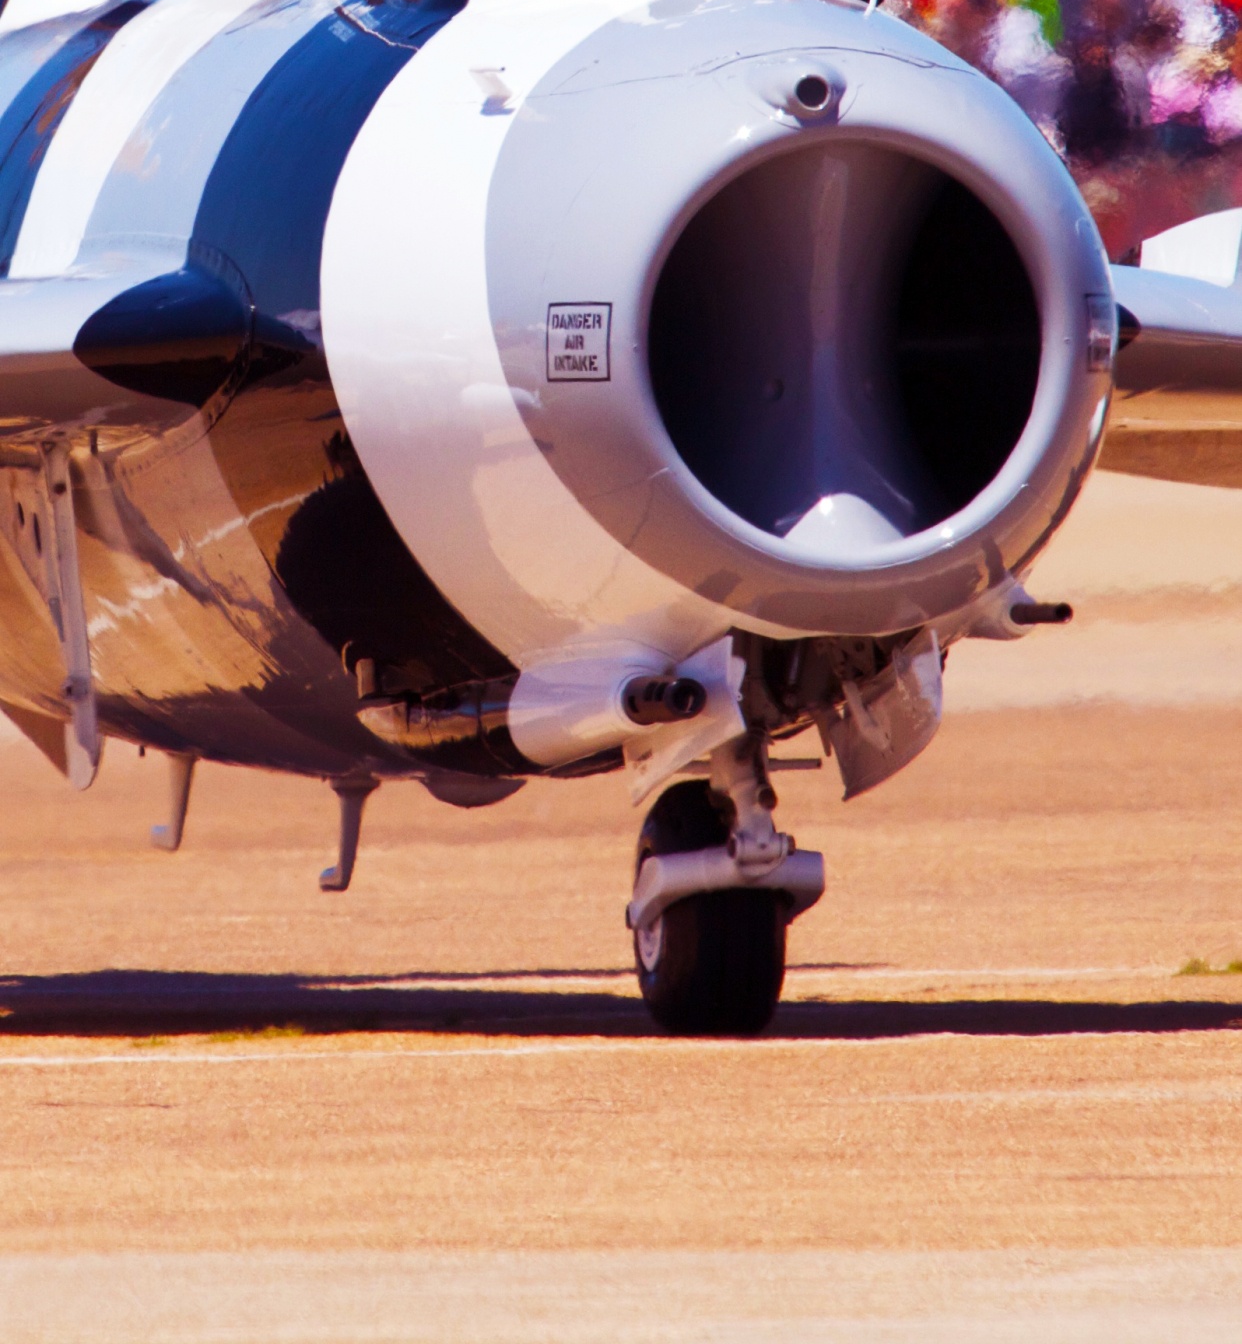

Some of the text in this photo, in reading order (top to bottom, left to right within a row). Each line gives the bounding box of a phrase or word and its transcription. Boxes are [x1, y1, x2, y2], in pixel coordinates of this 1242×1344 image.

[552, 313, 602, 329] DANGER
[564, 334, 585, 350] AIR
[553, 355, 598, 371] INTAKE
